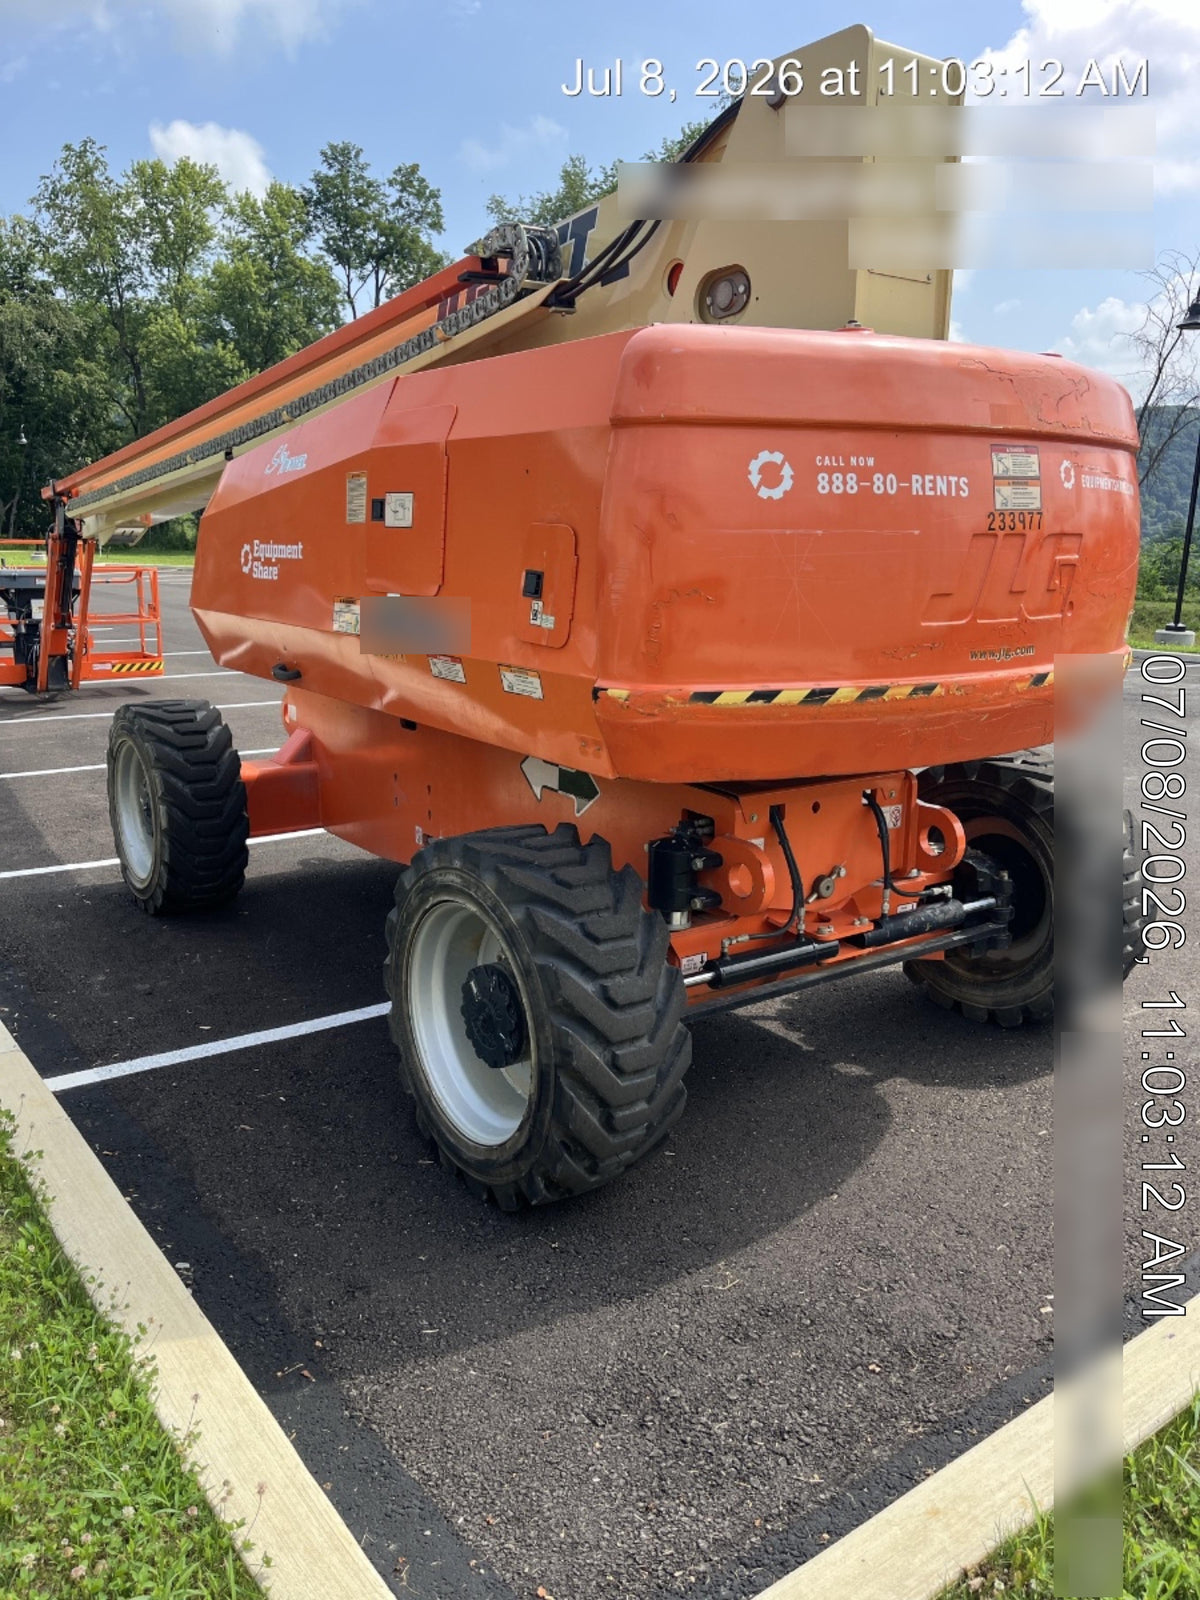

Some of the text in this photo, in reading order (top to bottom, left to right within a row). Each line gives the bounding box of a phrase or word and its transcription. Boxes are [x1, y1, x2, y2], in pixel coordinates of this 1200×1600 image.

[815, 455, 875, 467] CALL NOW
[816, 472, 969, 498] 888-80-RENTS
[987, 511, 1043, 532] 233977
[253, 539, 303, 562] Equipment
[252, 561, 279, 580] Share
[969, 644, 1035, 662] www.jlg.com
